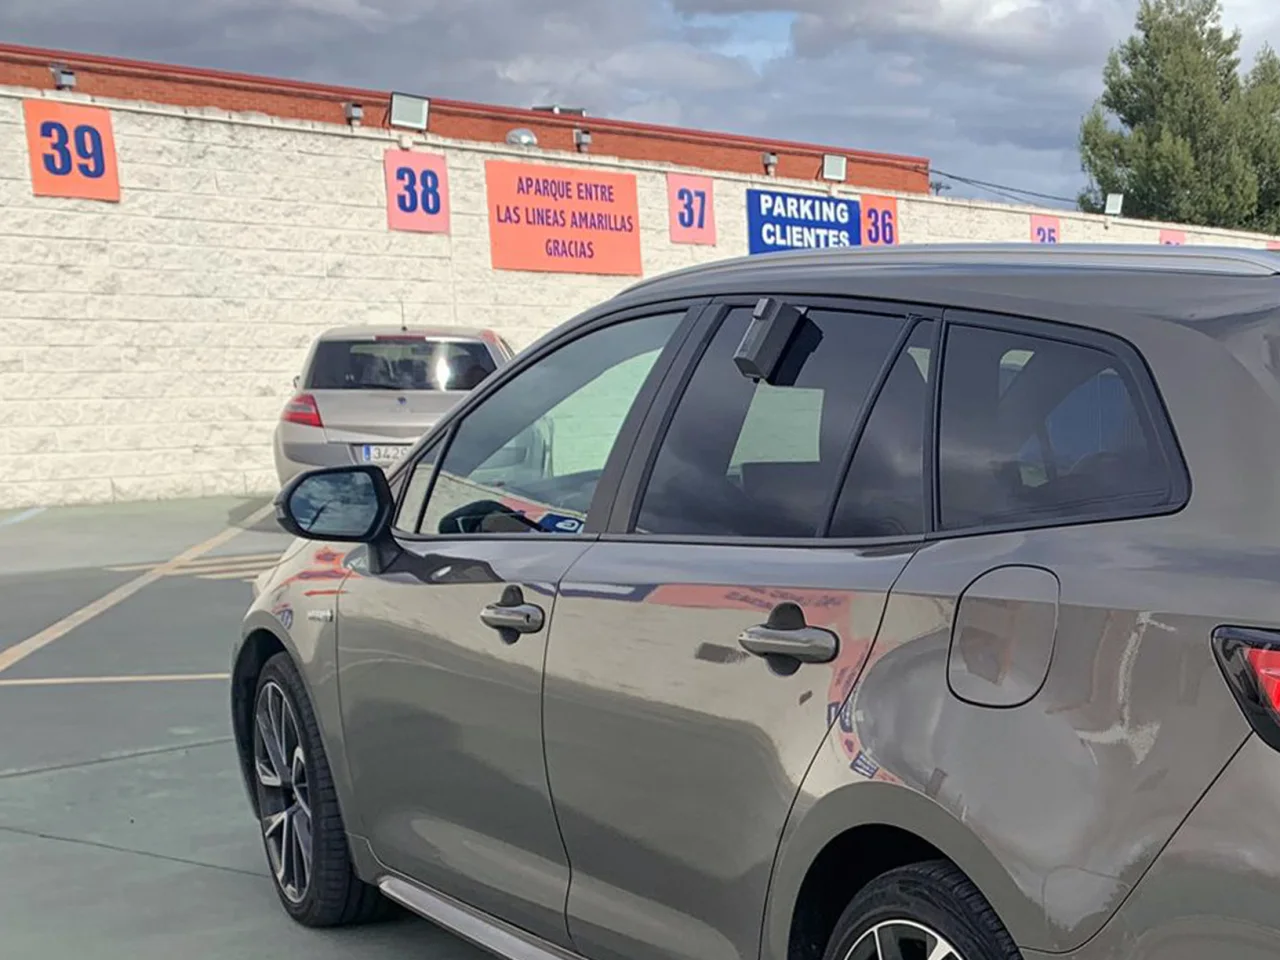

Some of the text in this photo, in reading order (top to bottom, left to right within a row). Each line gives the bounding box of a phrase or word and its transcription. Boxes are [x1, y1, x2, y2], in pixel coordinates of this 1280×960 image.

[40, 121, 106, 180] 39
[395, 166, 441, 216] 38
[516, 176, 615, 203] APARQUE ENTRE
[496, 204, 634, 233] LAS LINEAS AMARILLAS
[677, 187, 706, 229] 37
[759, 194, 849, 224] PARKING
[761, 222, 850, 248] CLIENTES
[867, 208, 894, 244] 36
[545, 238, 594, 259] GRACIAS
